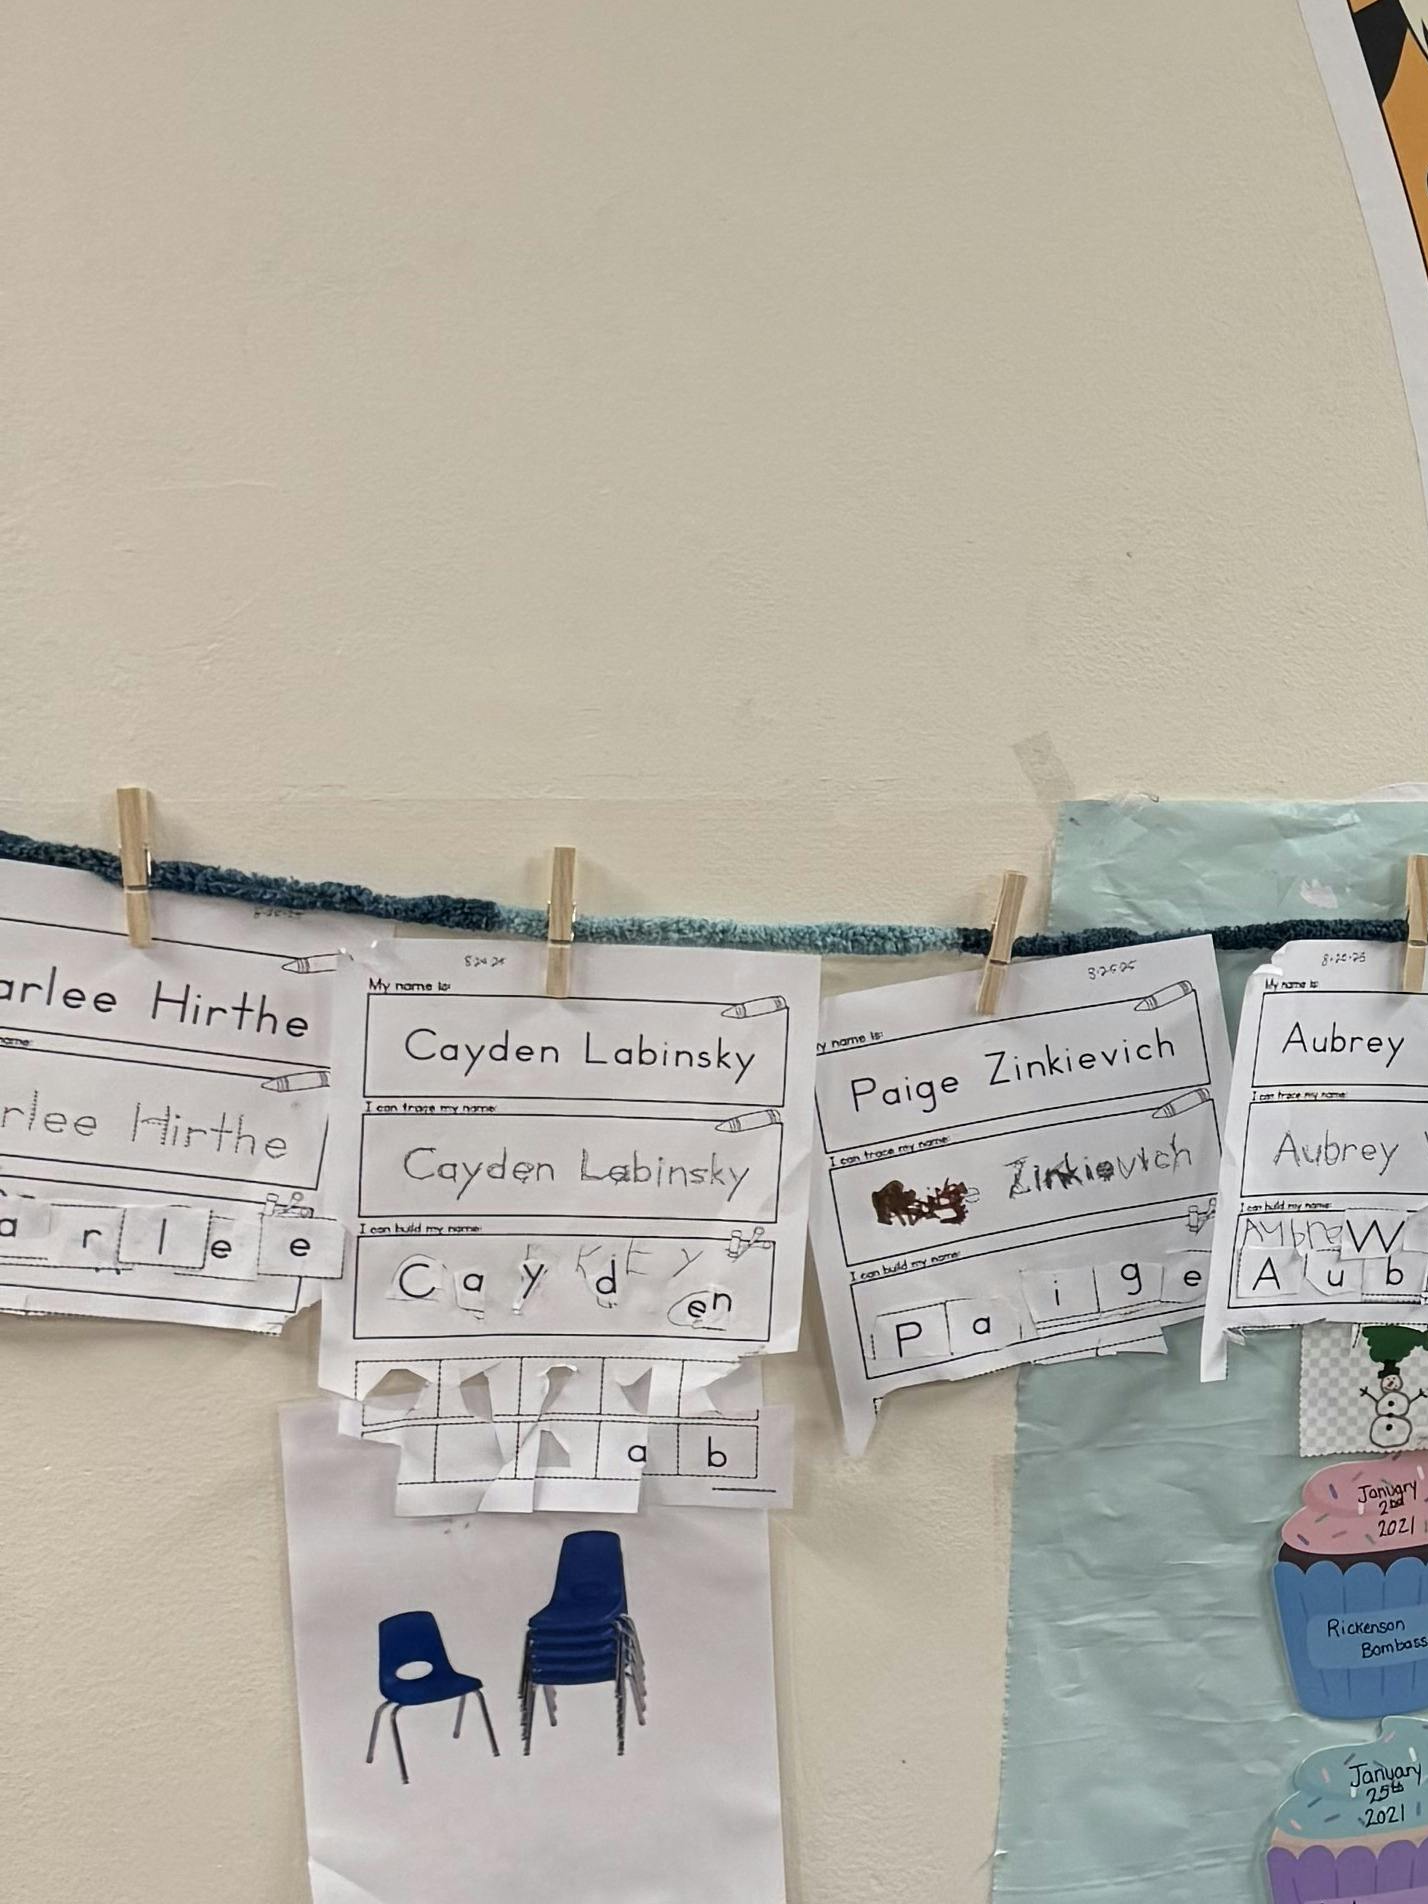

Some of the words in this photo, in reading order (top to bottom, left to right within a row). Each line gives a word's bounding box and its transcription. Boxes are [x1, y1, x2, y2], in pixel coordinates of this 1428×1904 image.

[370, 977, 388, 994] My
[396, 982, 432, 992] name
[152, 980, 309, 1038] Hirthe
[831, 1035, 866, 1050] name
[1282, 1021, 1405, 1069] Aubrey
[405, 1028, 559, 1077] Cayden
[585, 1031, 755, 1085] Labinsky
[851, 1075, 959, 1113] Paige
[985, 1027, 1174, 1086] Zinkievich
[133, 1102, 288, 1159] Hirthe
[865, 1147, 895, 1163] trace
[1274, 1129, 1399, 1176] Aubrey
[404, 1147, 555, 1201] Cayden
[581, 1148, 750, 1202] Labinsky
[883, 1261, 907, 1276] build
[1358, 1480, 1418, 1503] January
[1378, 1516, 1415, 1537] 2021
[1327, 1618, 1406, 1639] Rickenson
[1349, 1763, 1422, 1790] January
[1367, 1782, 1405, 1804] 25th
[1365, 1805, 1406, 1827] 2021
